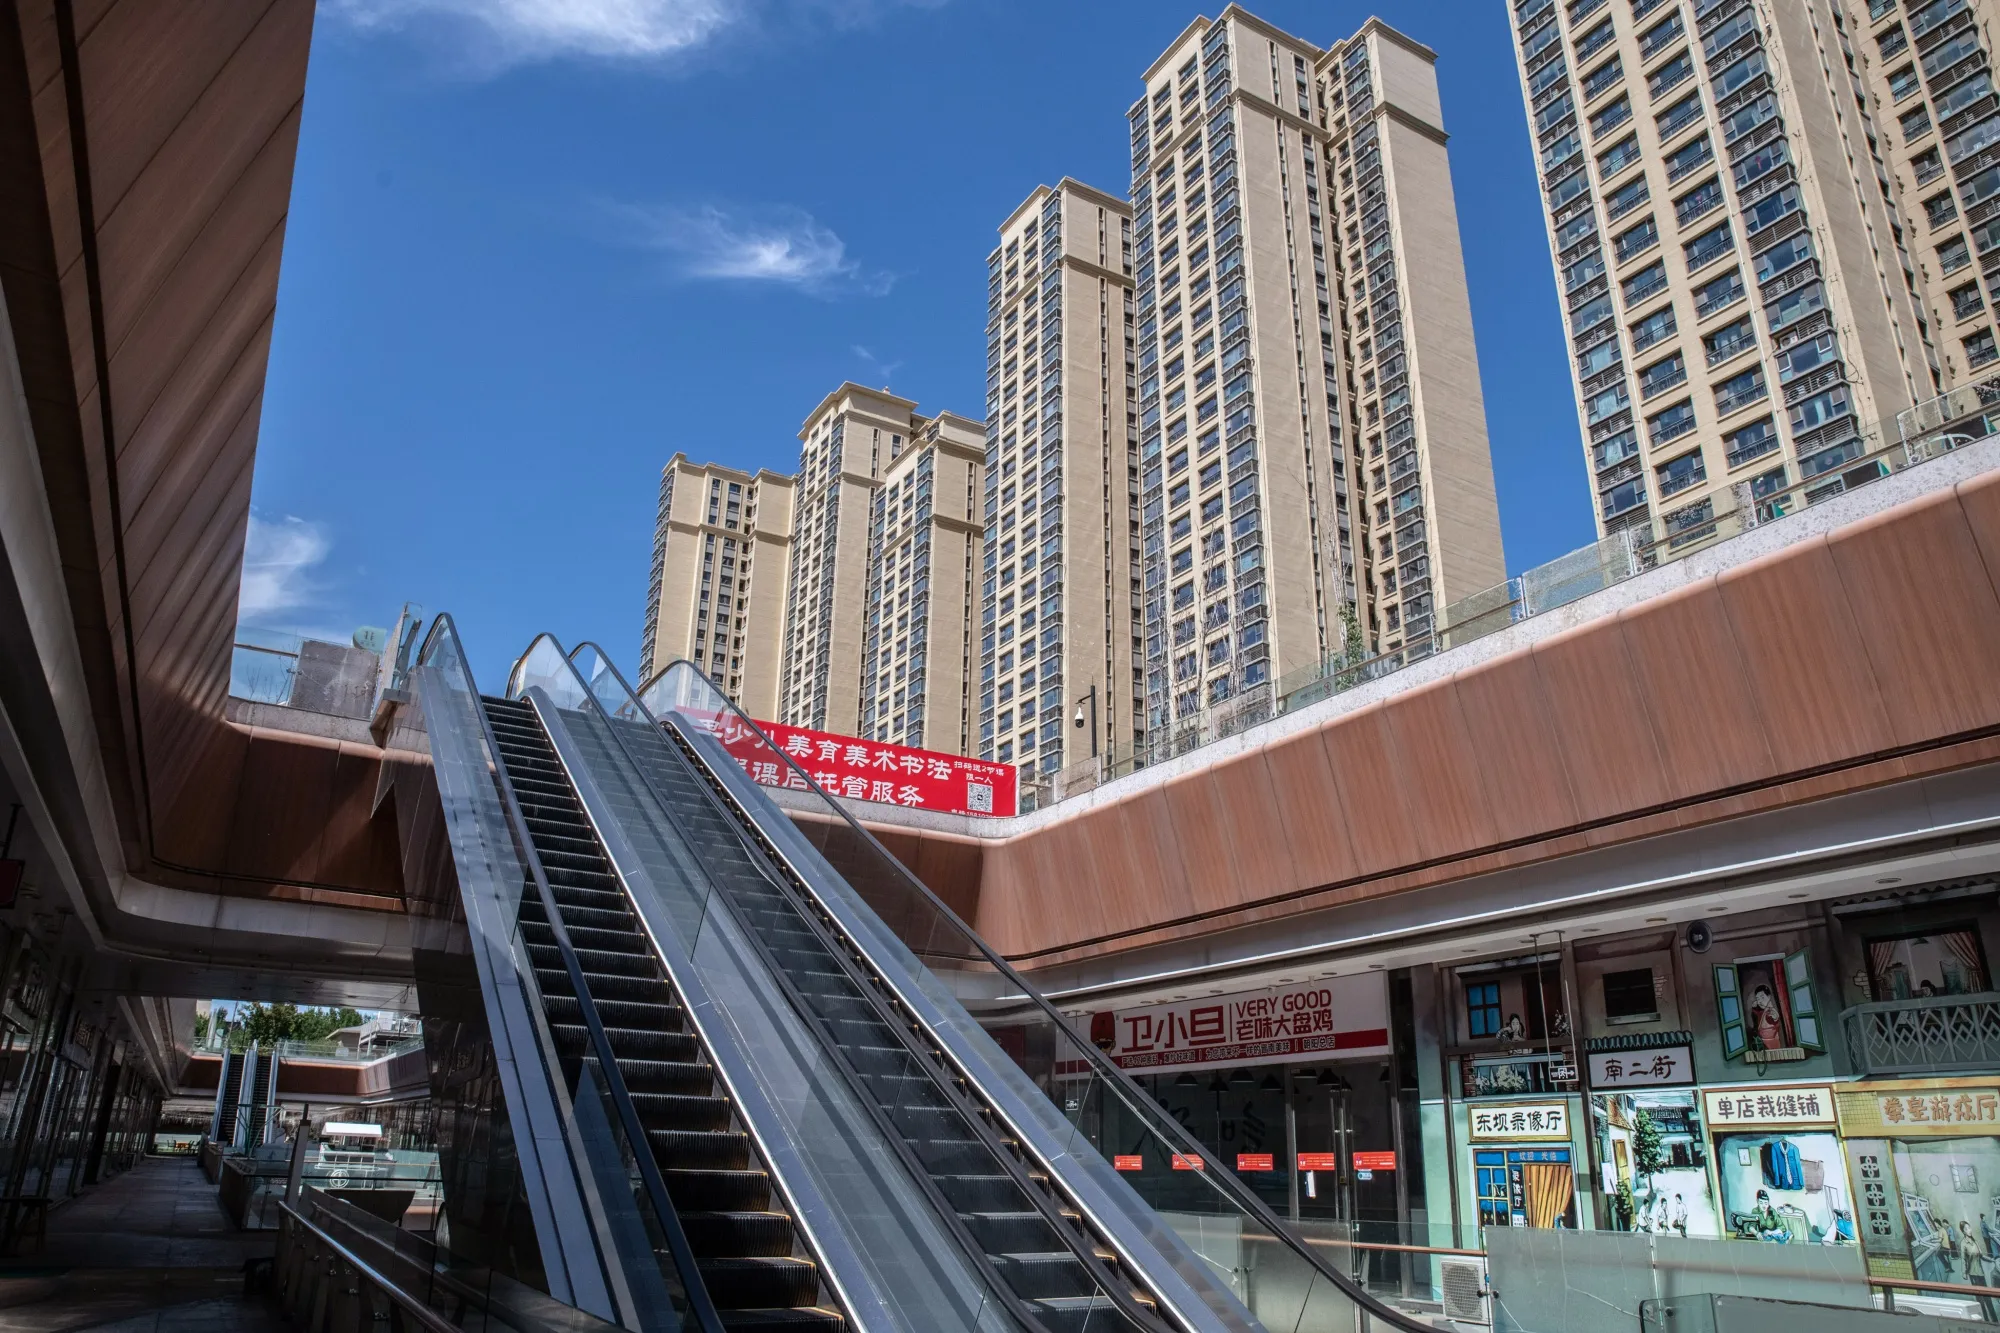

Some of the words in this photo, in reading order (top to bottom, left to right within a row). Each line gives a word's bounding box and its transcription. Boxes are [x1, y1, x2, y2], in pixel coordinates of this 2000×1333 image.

[733, 757, 925, 807] 课后托管服务
[965, 772, 993, 785] 限一人
[1235, 996, 1279, 1019] VERY
[1282, 989, 1332, 1012] GOOD
[1121, 1004, 1227, 1053] 卫小旦
[1235, 1008, 1334, 1042] 老味大盘鸡
[1302, 1035, 1336, 1050] 朝阳总店
[1603, 1055, 1677, 1082] 南二街
[1717, 1093, 1821, 1119] 单店裁缝铺
[1476, 1110, 1563, 1132] 东坝录像厅
